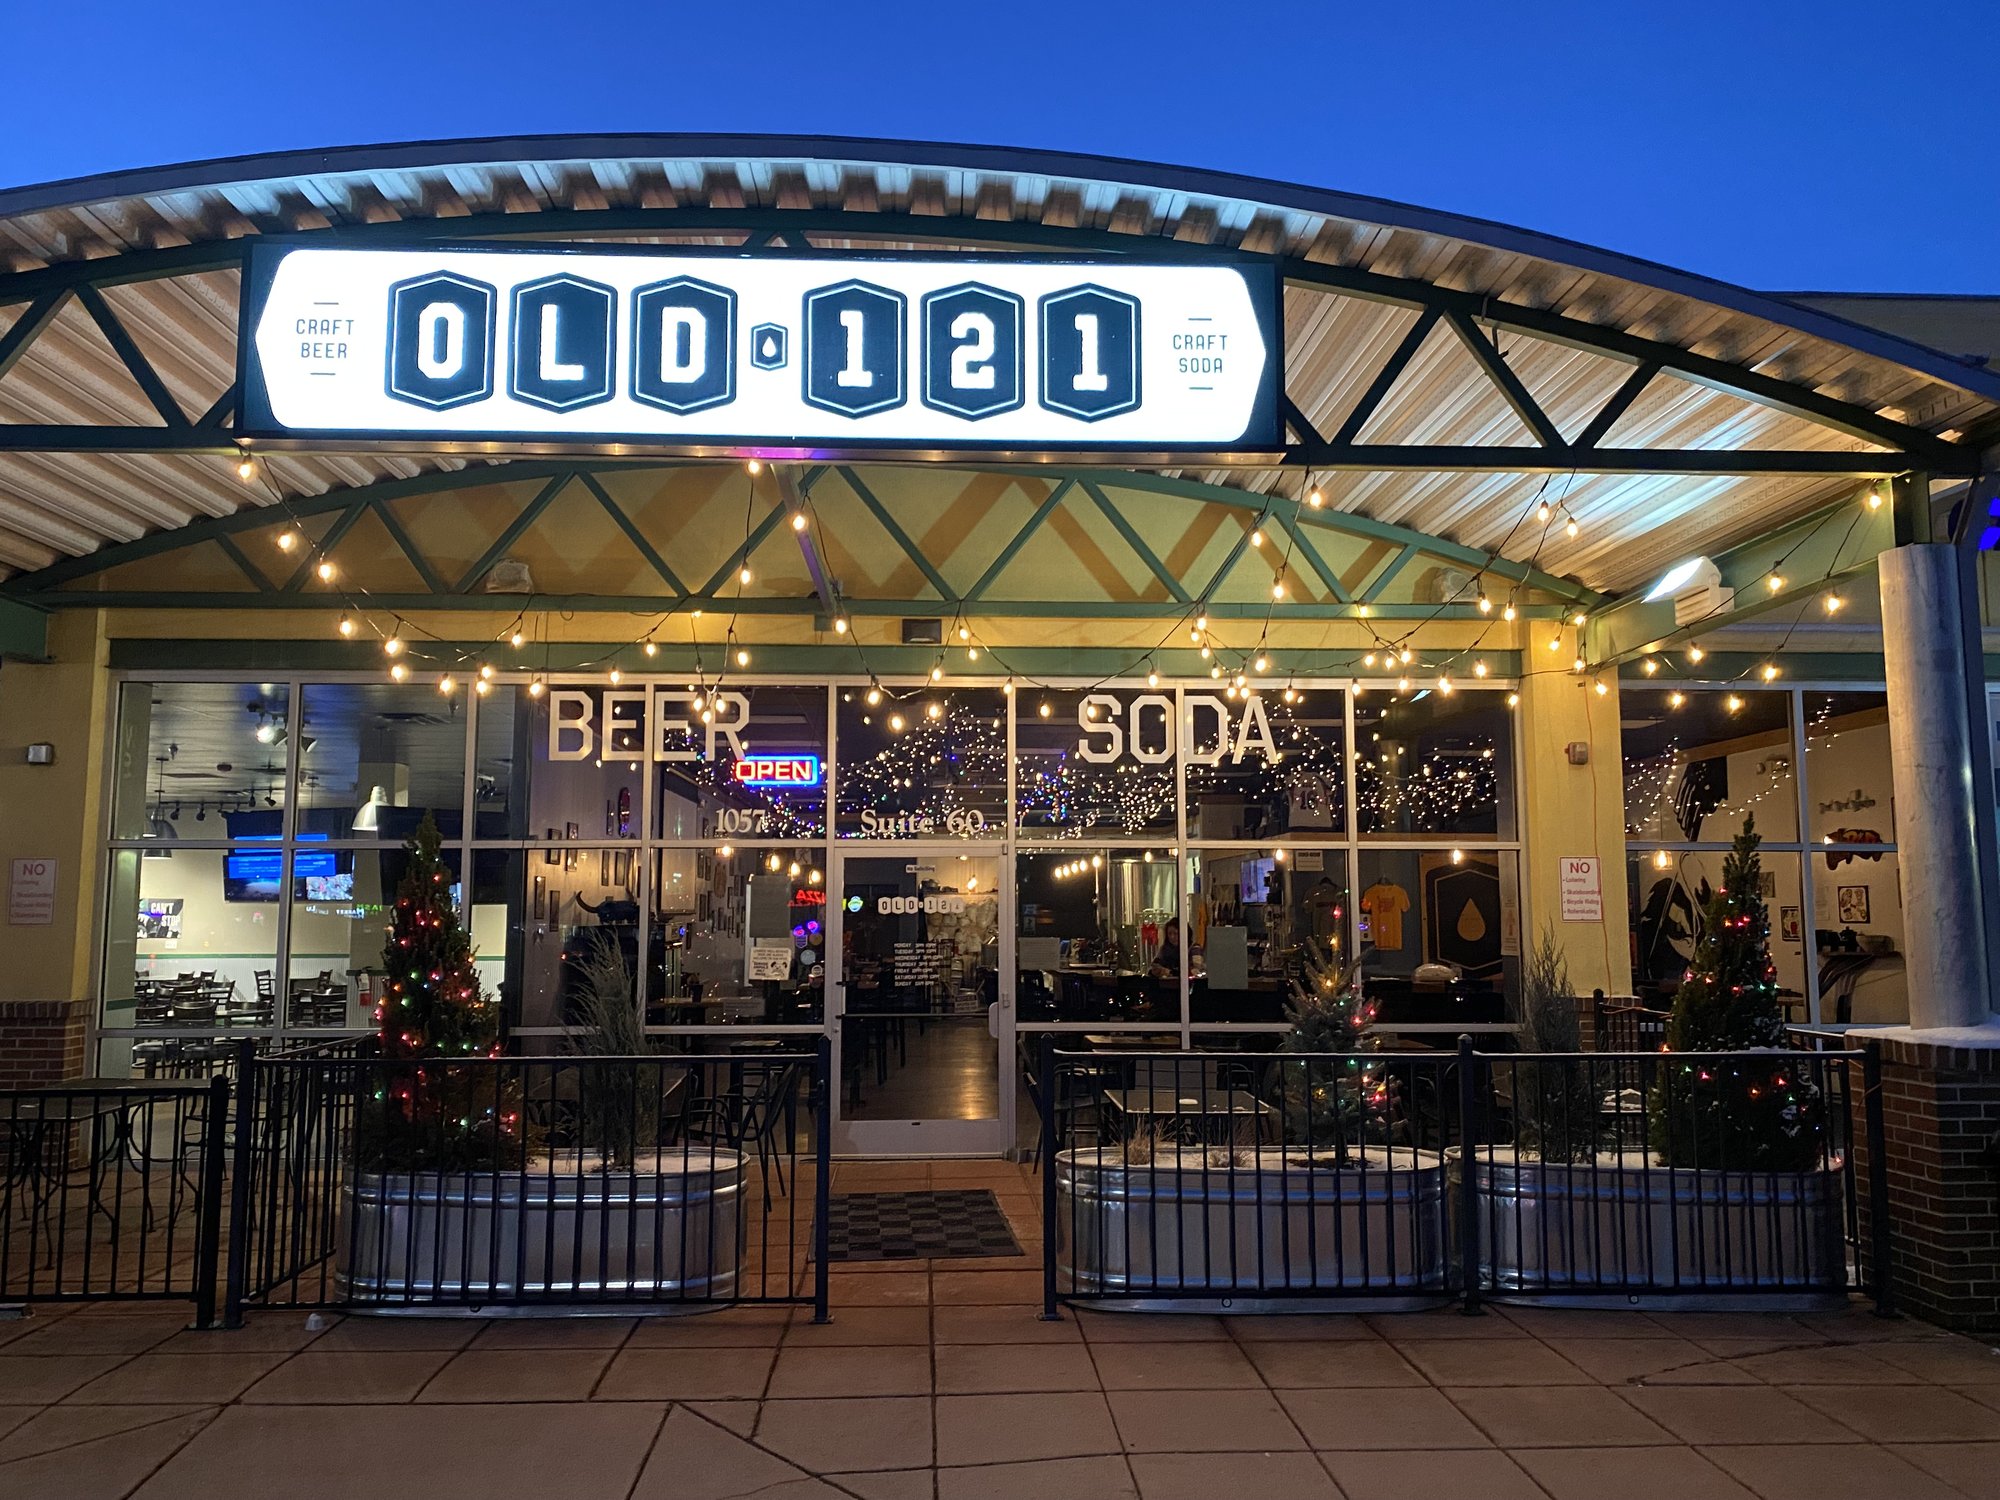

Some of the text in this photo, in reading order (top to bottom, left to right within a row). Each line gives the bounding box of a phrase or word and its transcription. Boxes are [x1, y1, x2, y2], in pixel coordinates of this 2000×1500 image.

[295, 318, 355, 336] CRAFT
[300, 342, 348, 360] BEER
[417, 301, 1109, 392] OLD 121
[1172, 333, 1229, 351] CRAFT
[1179, 357, 1224, 374] SODA
[548, 690, 749, 761] BEER
[1078, 694, 1279, 765] SODA
[736, 760, 813, 781] OPEN
[714, 808, 766, 833] 1057
[860, 808, 985, 834] Suite 60
[22, 863, 46, 876] NO
[1570, 862, 1591, 874] NO
[881, 900, 915, 911] OLD
